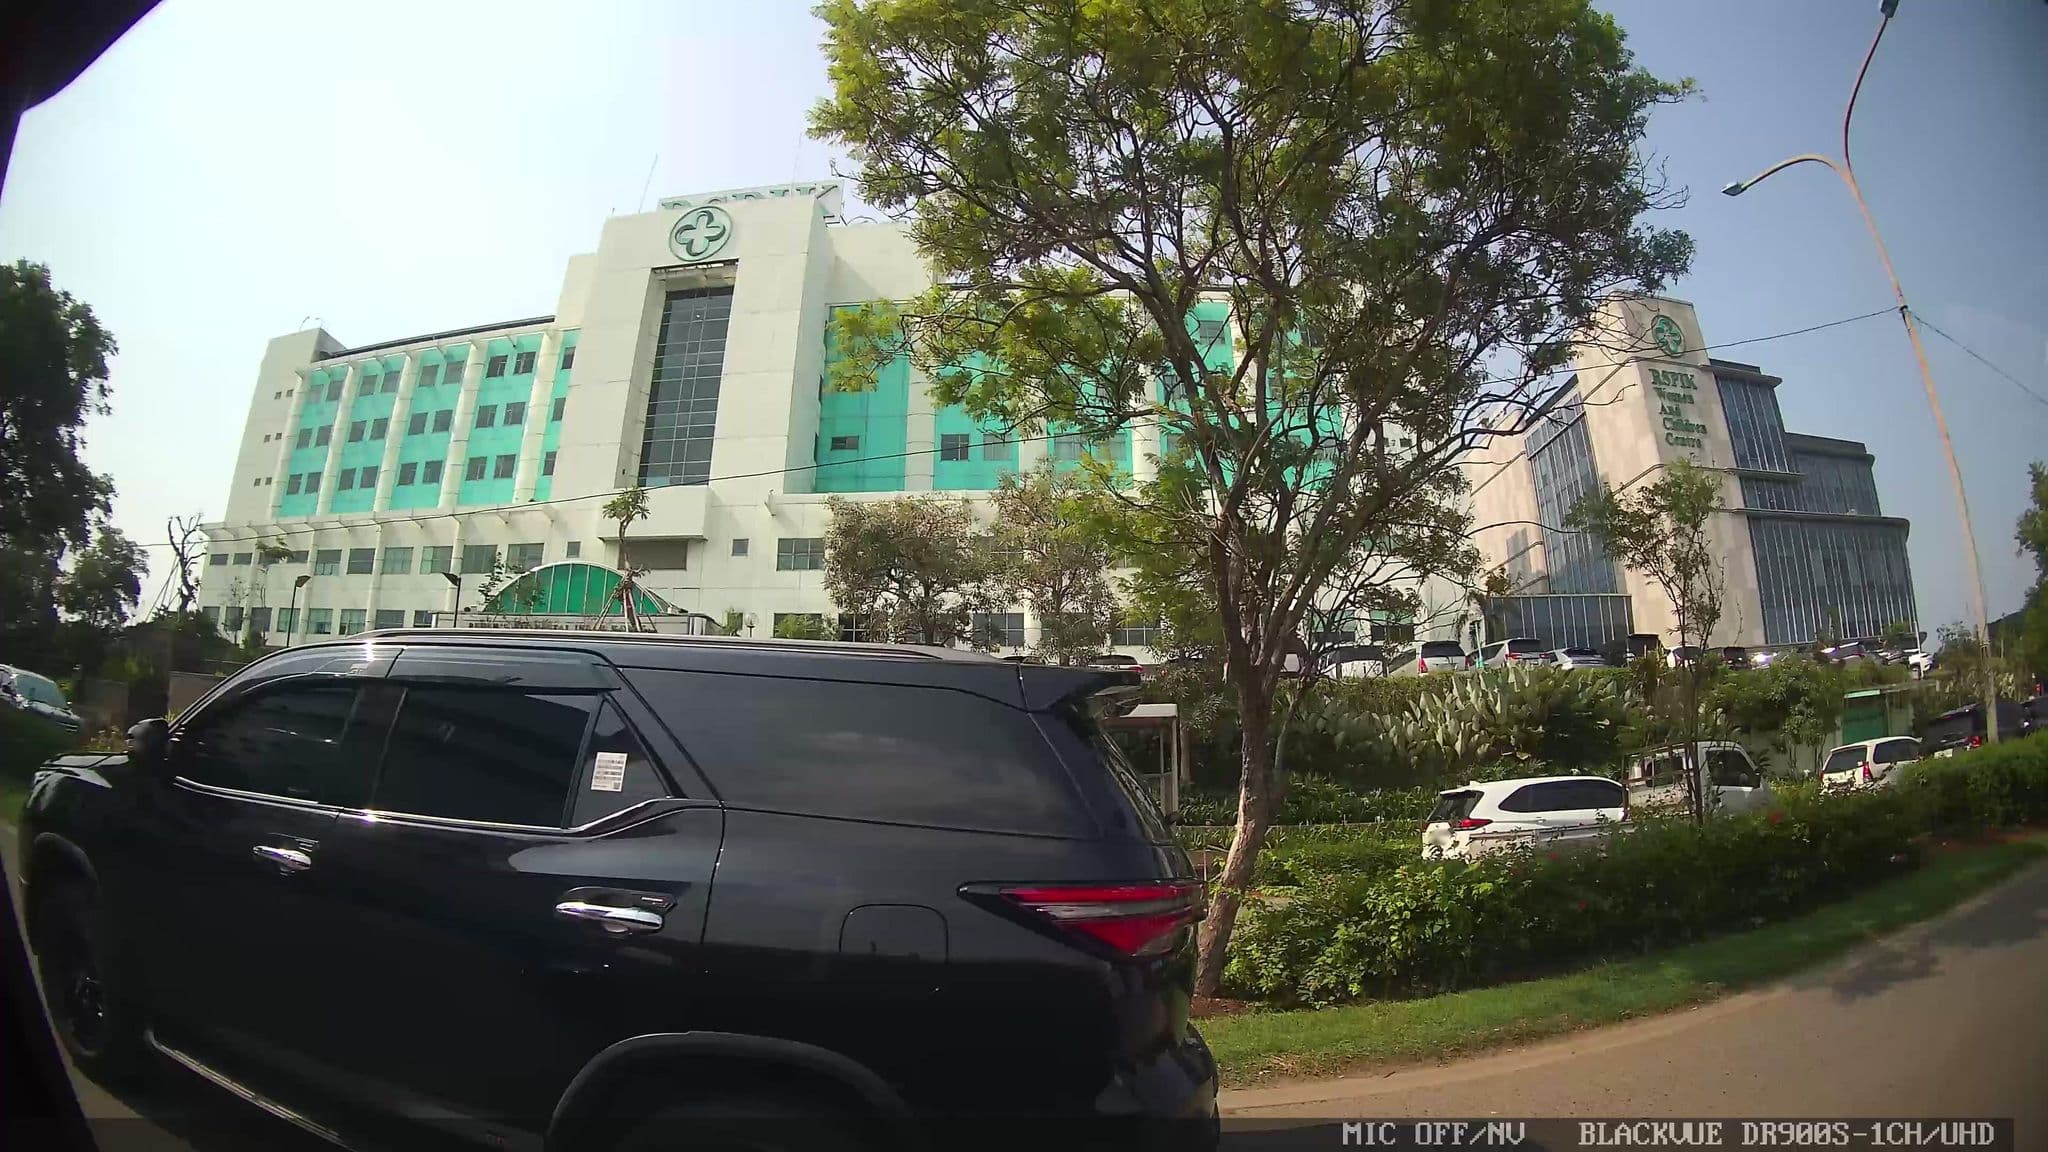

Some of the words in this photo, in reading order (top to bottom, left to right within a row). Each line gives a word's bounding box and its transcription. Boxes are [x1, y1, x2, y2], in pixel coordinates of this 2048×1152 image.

[1648, 368, 1698, 390] RSPIK
[1653, 387, 1695, 404] Women
[1659, 402, 1681, 417] And
[1663, 417, 1708, 434] Children
